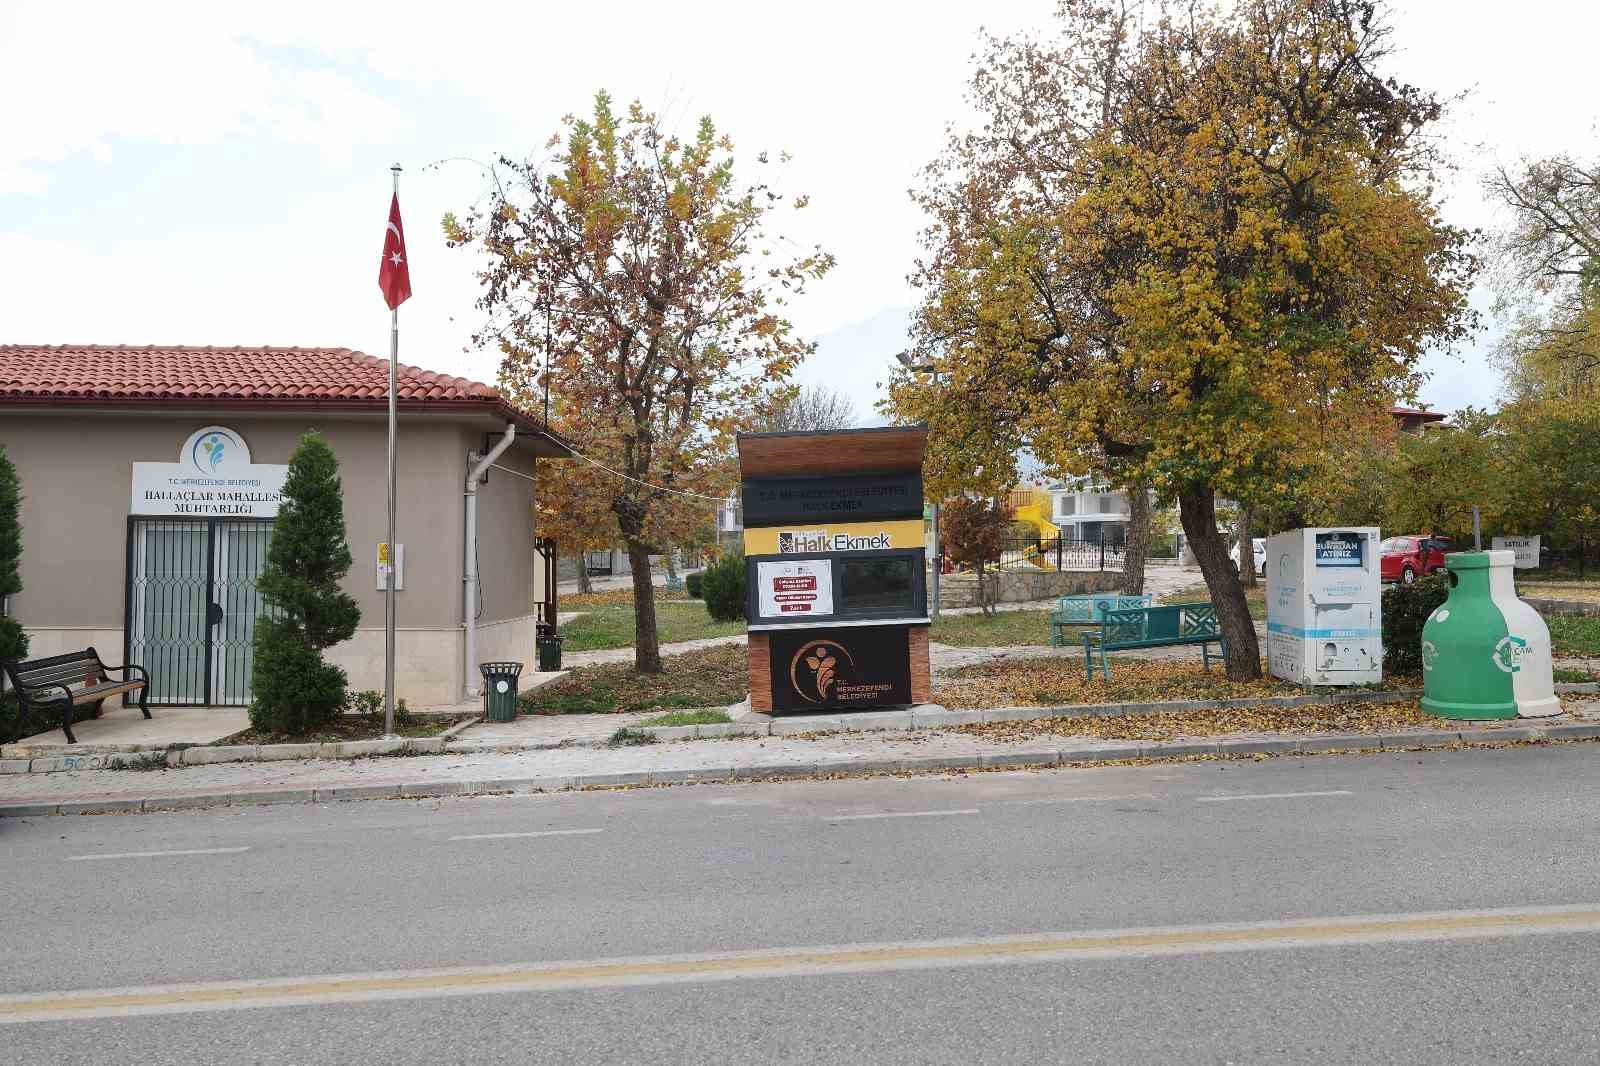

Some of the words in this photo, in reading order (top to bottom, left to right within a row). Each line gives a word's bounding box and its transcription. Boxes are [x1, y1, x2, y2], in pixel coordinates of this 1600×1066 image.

[145, 490, 213, 502] HALLAÇLAR
[175, 503, 253, 514] MUHTARLIĞI
[795, 534, 831, 552] Halk
[834, 532, 890, 550] Ekmek
